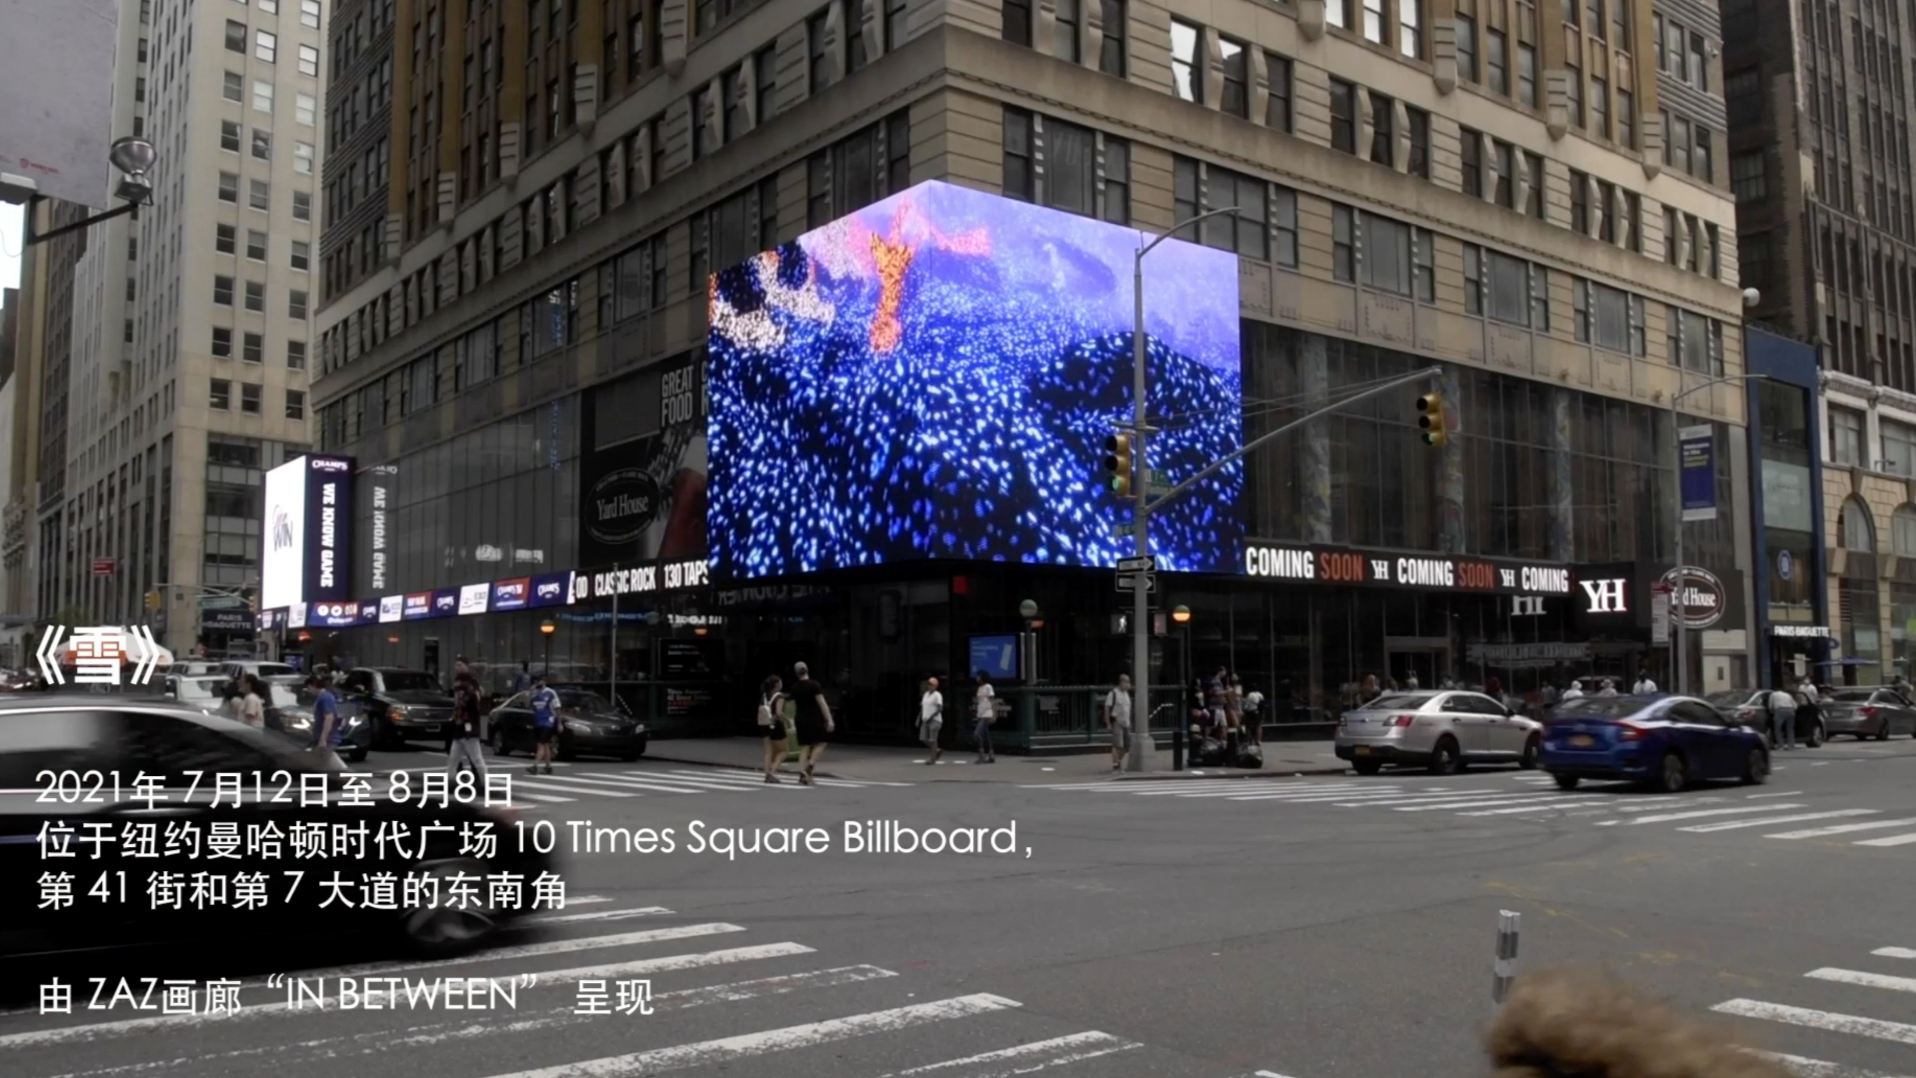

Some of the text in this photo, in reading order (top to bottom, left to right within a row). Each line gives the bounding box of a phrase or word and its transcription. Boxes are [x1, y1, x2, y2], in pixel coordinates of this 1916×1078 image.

[662, 365, 694, 398] GREAT
[662, 392, 693, 427] FOOD
[312, 459, 348, 471] CHAMPS
[322, 482, 336, 505] WE
[596, 493, 649, 521] Yard House
[321, 507, 335, 548] KNOW
[320, 549, 334, 588] GAME
[594, 569, 629, 597] CLASSIC
[630, 566, 656, 592] ROCK
[664, 563, 681, 588] 130
[683, 560, 710, 586] TAPS
[1245, 547, 1569, 593] COMING SOON YH COMING SOON YH COMING
[1579, 578, 1627, 613] YH
[1671, 587, 1688, 606] Yd
[1690, 587, 1716, 607] House
[217, 613, 243, 622] PARIS
[1774, 625, 1829, 637] PARIS BAGUETTE
